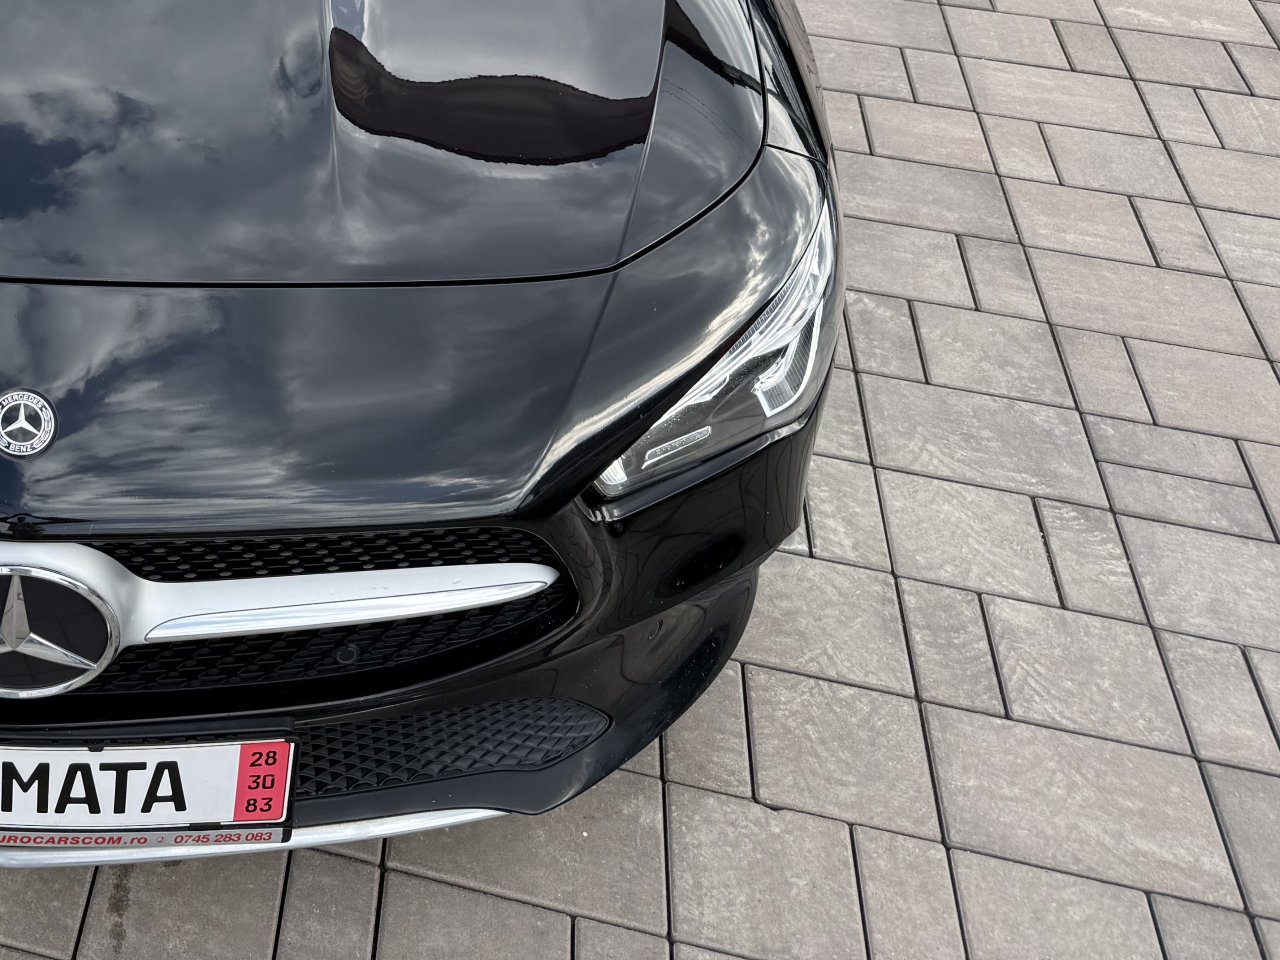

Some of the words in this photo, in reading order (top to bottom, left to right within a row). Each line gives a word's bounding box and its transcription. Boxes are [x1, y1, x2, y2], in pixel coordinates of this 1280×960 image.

[1, 394, 44, 408] MERCEDES
[9, 443, 33, 453] BENZ
[249, 750, 278, 767] 28
[247, 774, 276, 791] 30
[244, 797, 273, 813] 83
[174, 834, 212, 845] 0745
[215, 833, 242, 843] 283
[245, 831, 273, 842] 083
